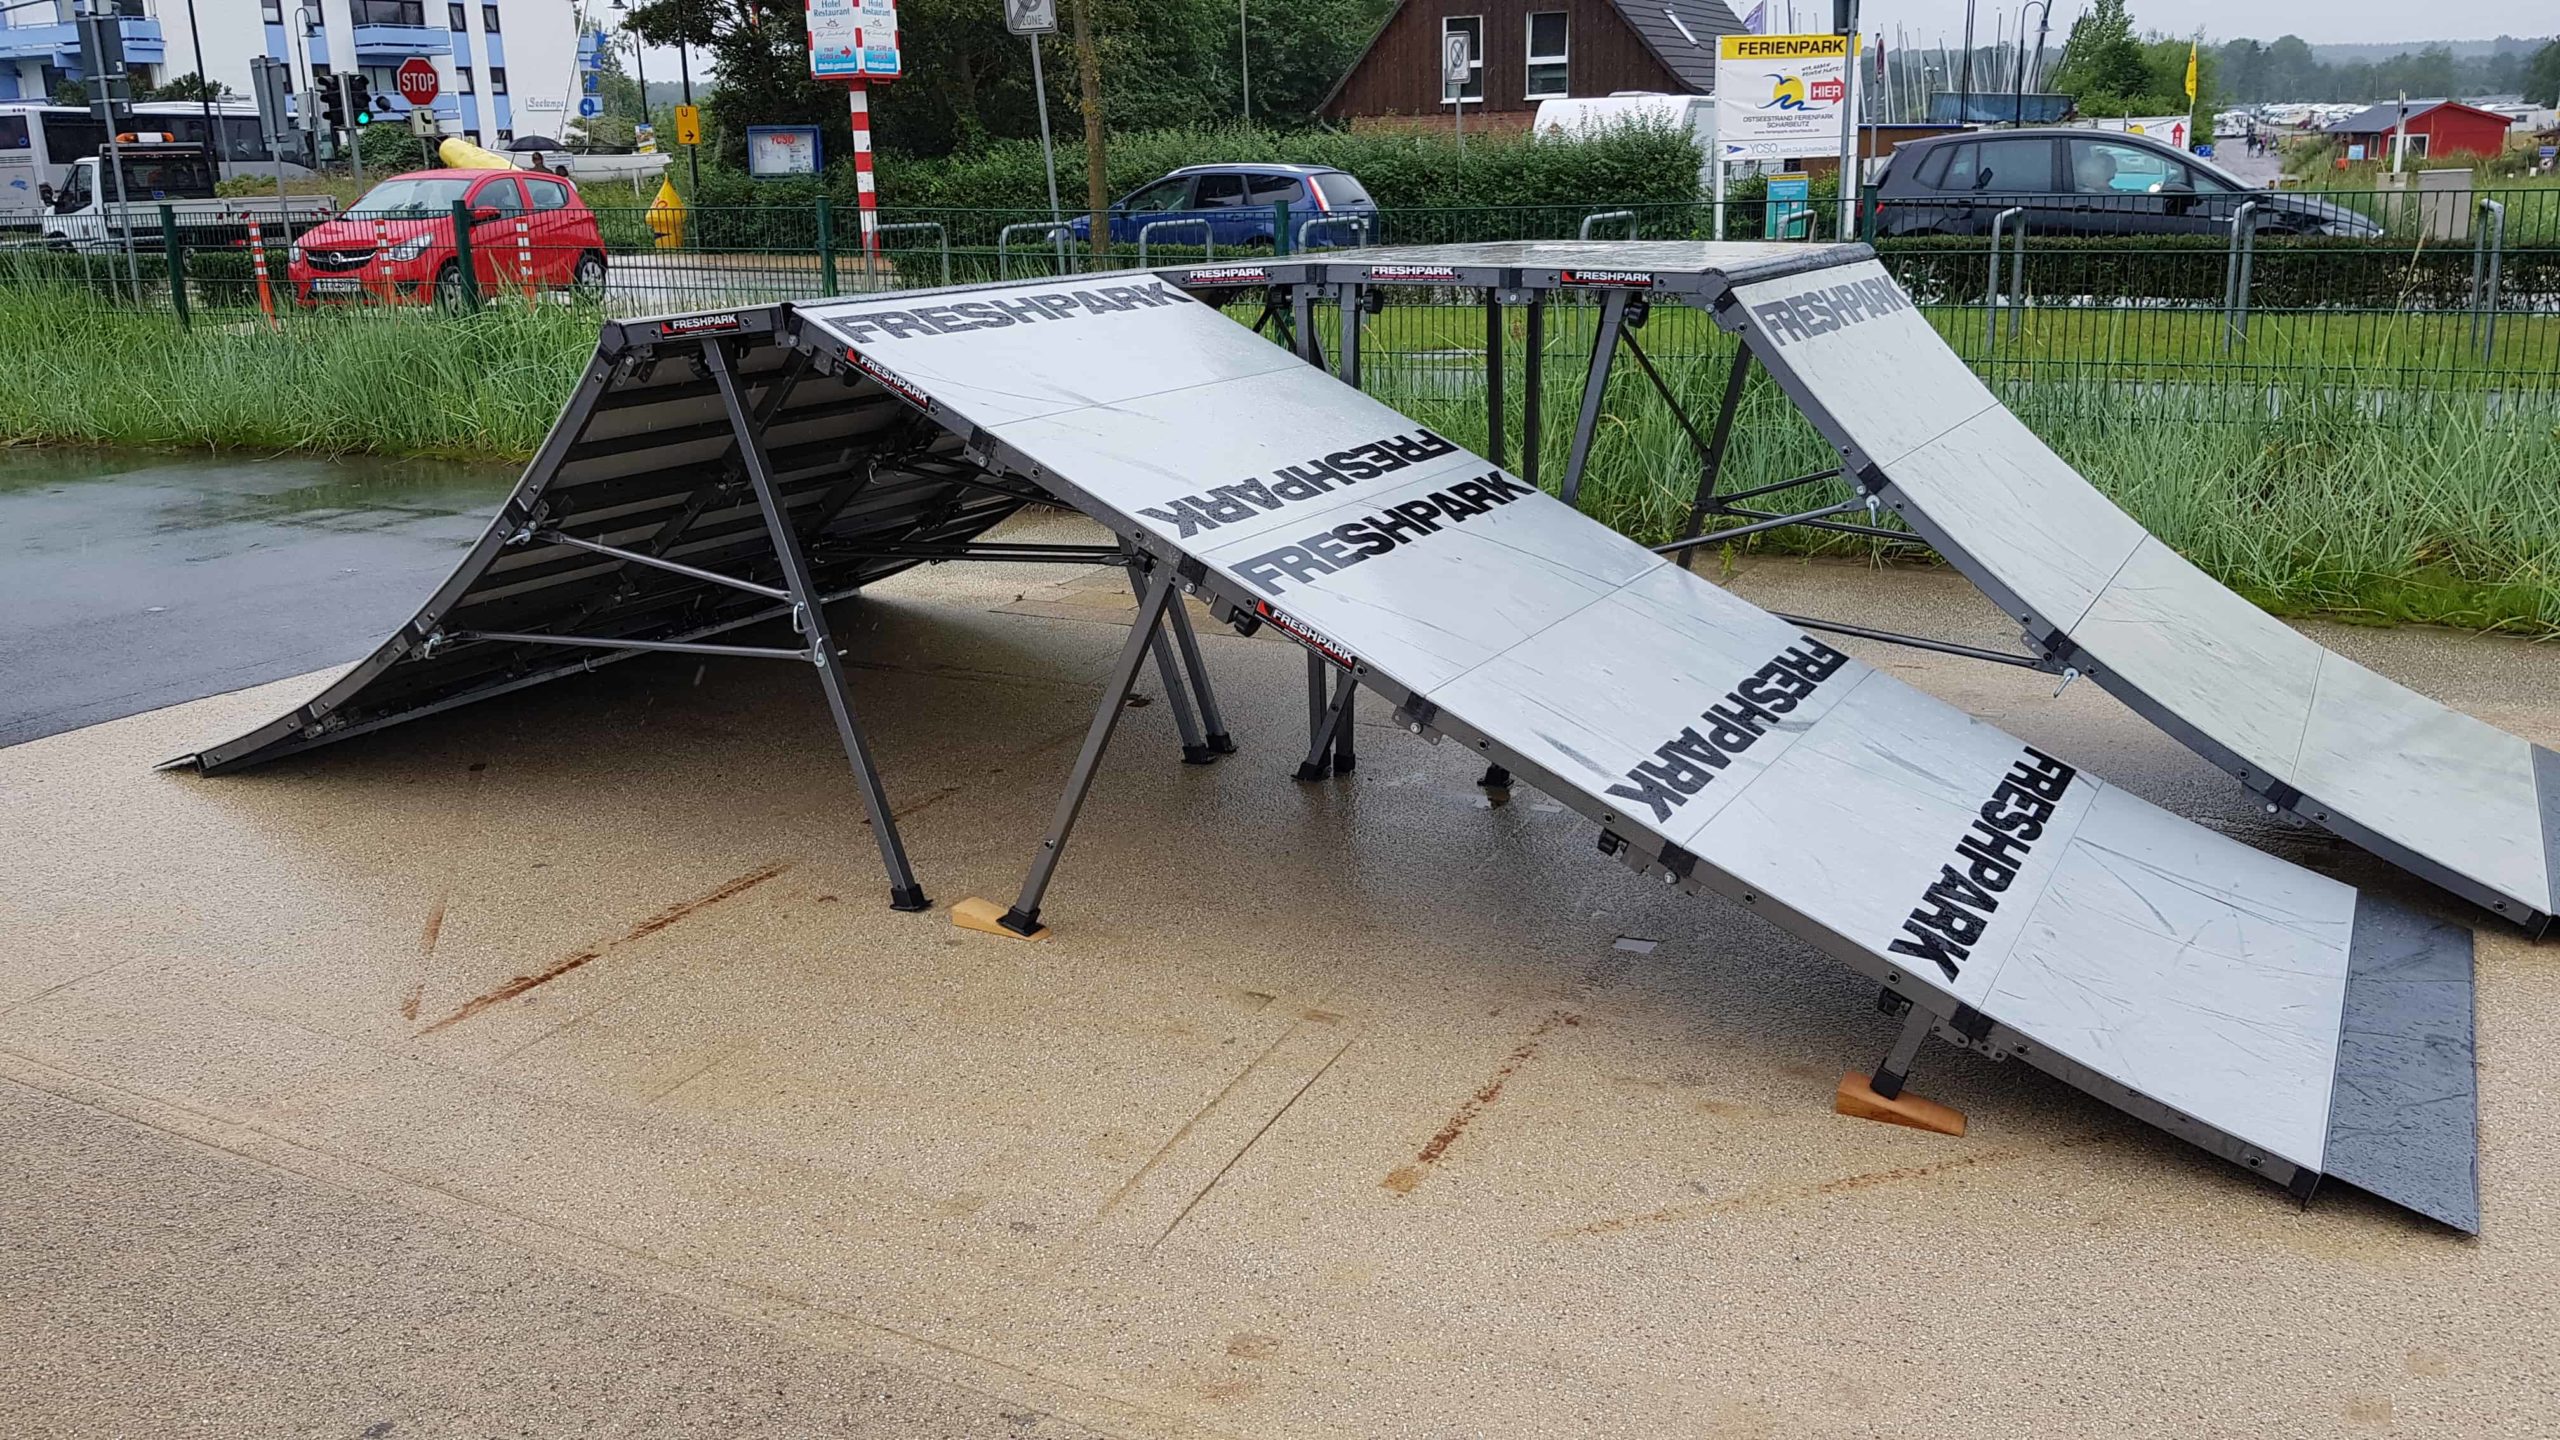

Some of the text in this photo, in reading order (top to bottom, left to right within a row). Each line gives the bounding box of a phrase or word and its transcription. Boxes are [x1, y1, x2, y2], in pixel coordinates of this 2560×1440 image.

[821, 0, 841, 8] Hotel
[813, 8, 850, 17] Restaurant
[862, 7, 891, 17] Restaurant
[1738, 40, 1844, 55] FERIENPARK
[402, 72, 435, 92] STOP
[1812, 85, 1841, 98] HIER
[681, 108, 688, 117] U
[1743, 113, 1834, 123] OSTSEESTRAND FERIENPARK
[1766, 121, 1810, 129] SCHARBEUTZ
[1750, 143, 1777, 154] YCSO
[1189, 267, 1265, 279] FRESHPARK
[1371, 266, 1454, 276] FRESHPARK
[1575, 271, 1652, 282] FRESHPARK
[822, 282, 1194, 344] FRESHPARK
[1751, 274, 1912, 347] FRESHPARK
[672, 313, 737, 330] FRESHPARK
[860, 355, 928, 404] FRESHPARK
[1136, 428, 1460, 540] FRESHPARK
[1228, 469, 1537, 597] FRESHPARK
[1272, 608, 1353, 664] FRESHPARK
[1603, 635, 1850, 825] FRESHPARK
[1887, 745, 2077, 985] FRESHPARK
